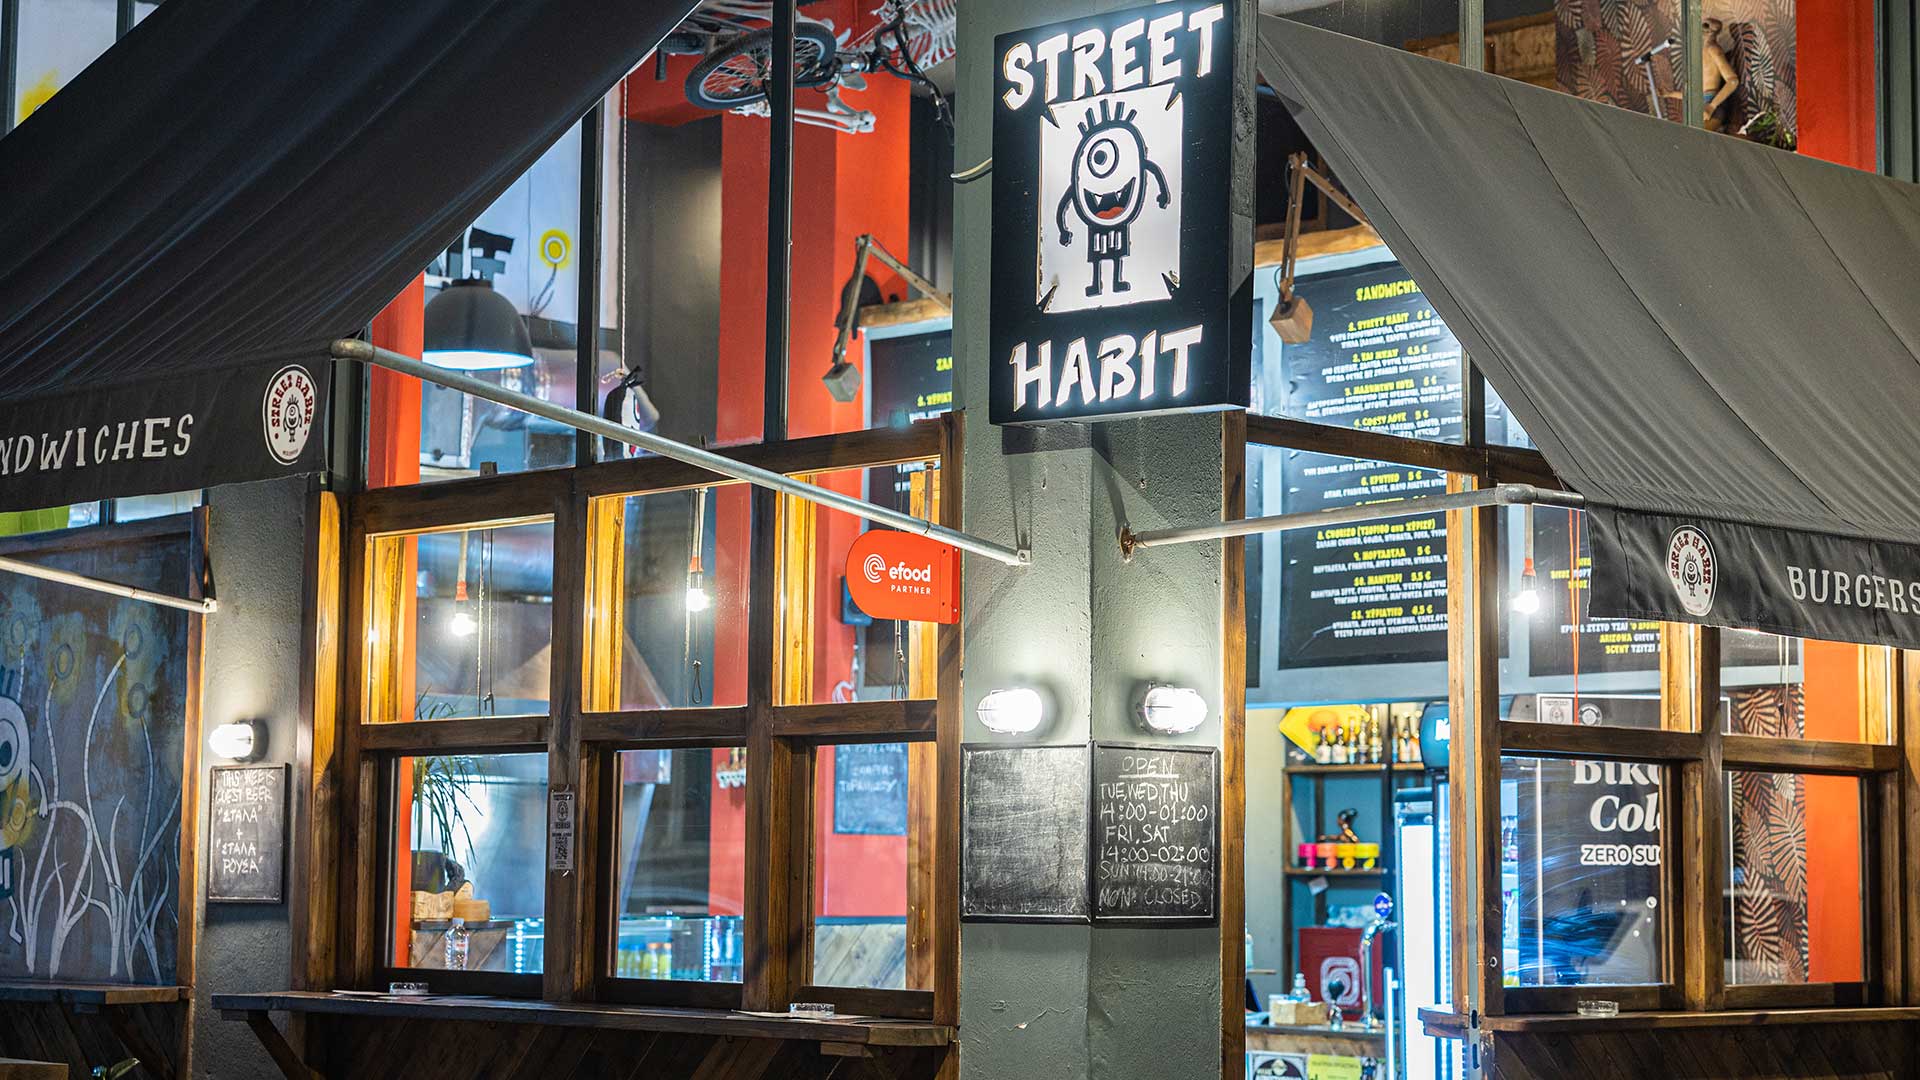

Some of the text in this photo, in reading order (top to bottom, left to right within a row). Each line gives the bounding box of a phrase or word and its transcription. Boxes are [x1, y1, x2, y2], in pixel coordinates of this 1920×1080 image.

[1002, 3, 1225, 111] STREET
[1008, 323, 1204, 412] HABIT
[271, 374, 313, 428] STREET HABIT
[1671, 532, 1711, 584] STREET HABIT
[889, 561, 931, 582] efood
[890, 584, 931, 595] PARTNER
[1599, 633, 1632, 643] ARIZONA
[1121, 755, 1176, 774] OPEN
[221, 769, 276, 787] THIS WEEK
[246, 786, 273, 803] BEER
[236, 828, 243, 841] +
[1583, 846, 1660, 863] ZERO SU
[1144, 887, 1201, 909] CLOSED
